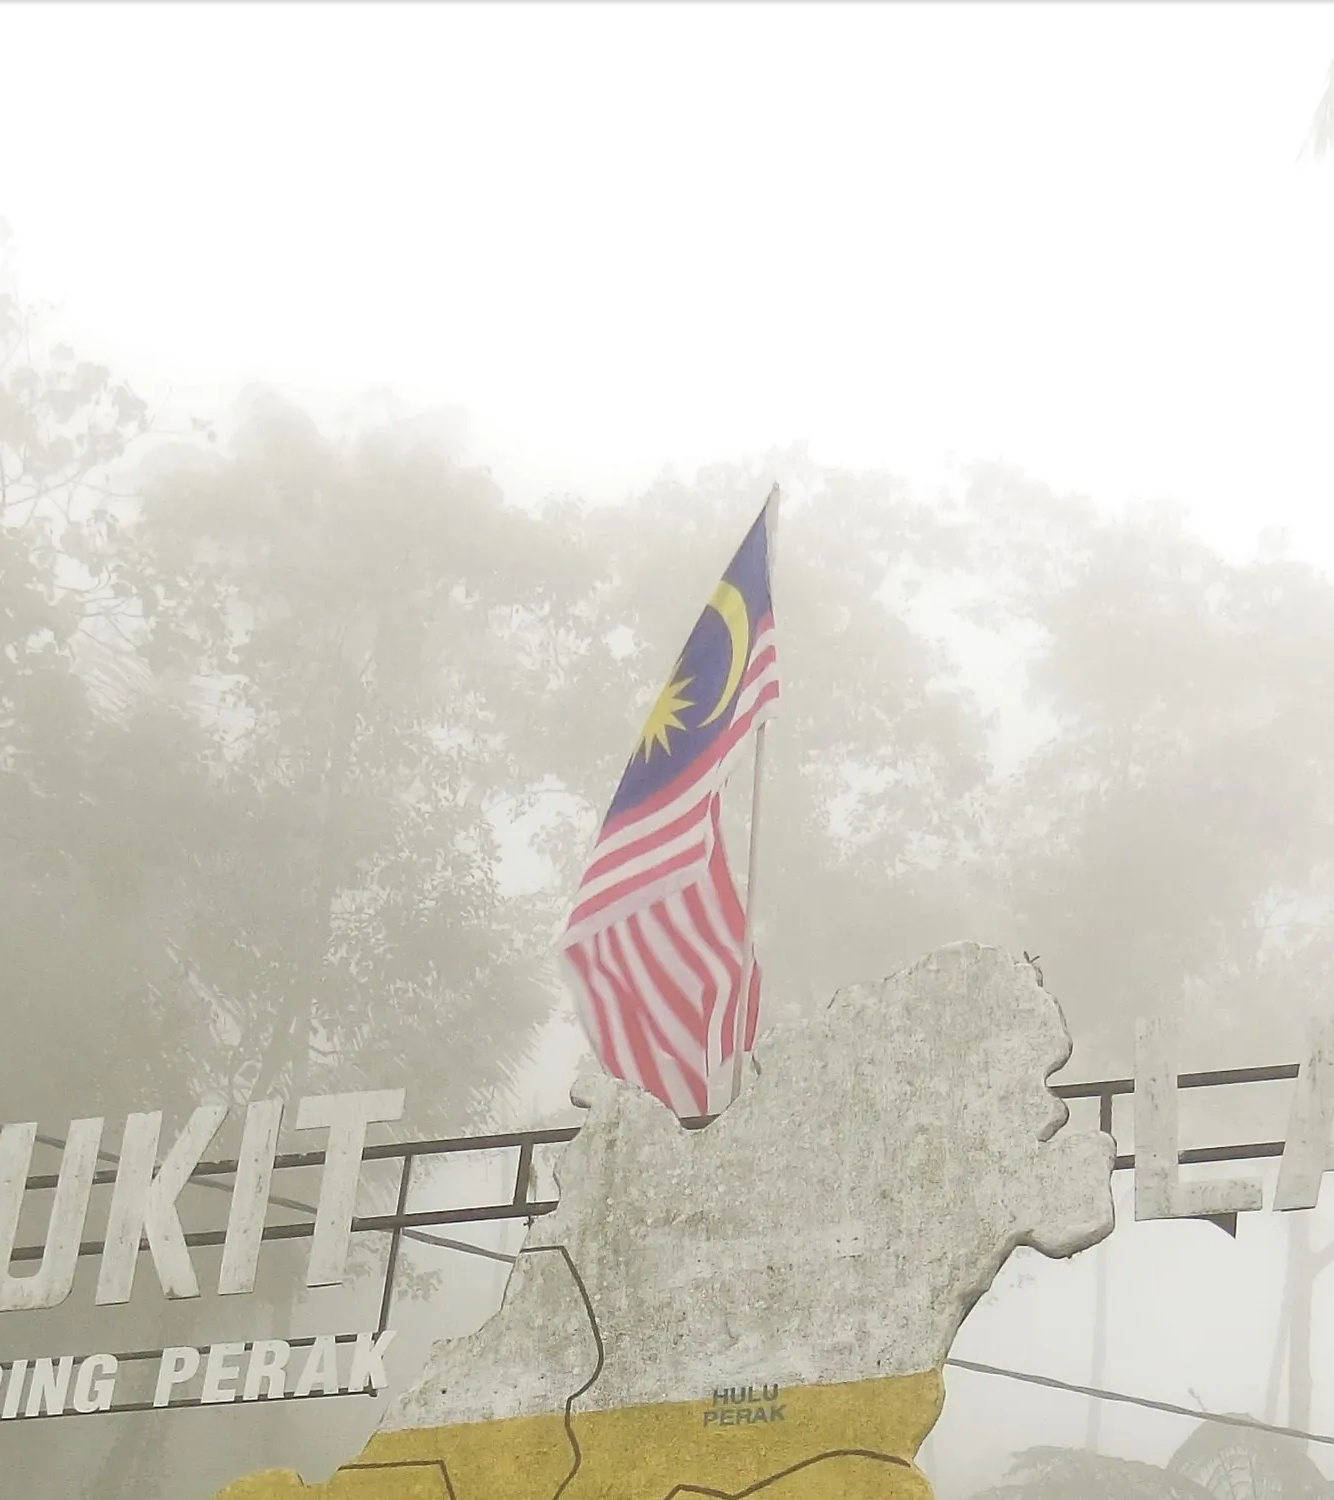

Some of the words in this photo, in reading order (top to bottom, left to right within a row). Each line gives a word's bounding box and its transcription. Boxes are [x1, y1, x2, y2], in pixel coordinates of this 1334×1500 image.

[154, 1330, 395, 1408] PERAK
[712, 1382, 779, 1408] HULU
[703, 1404, 786, 1428] PERAK
